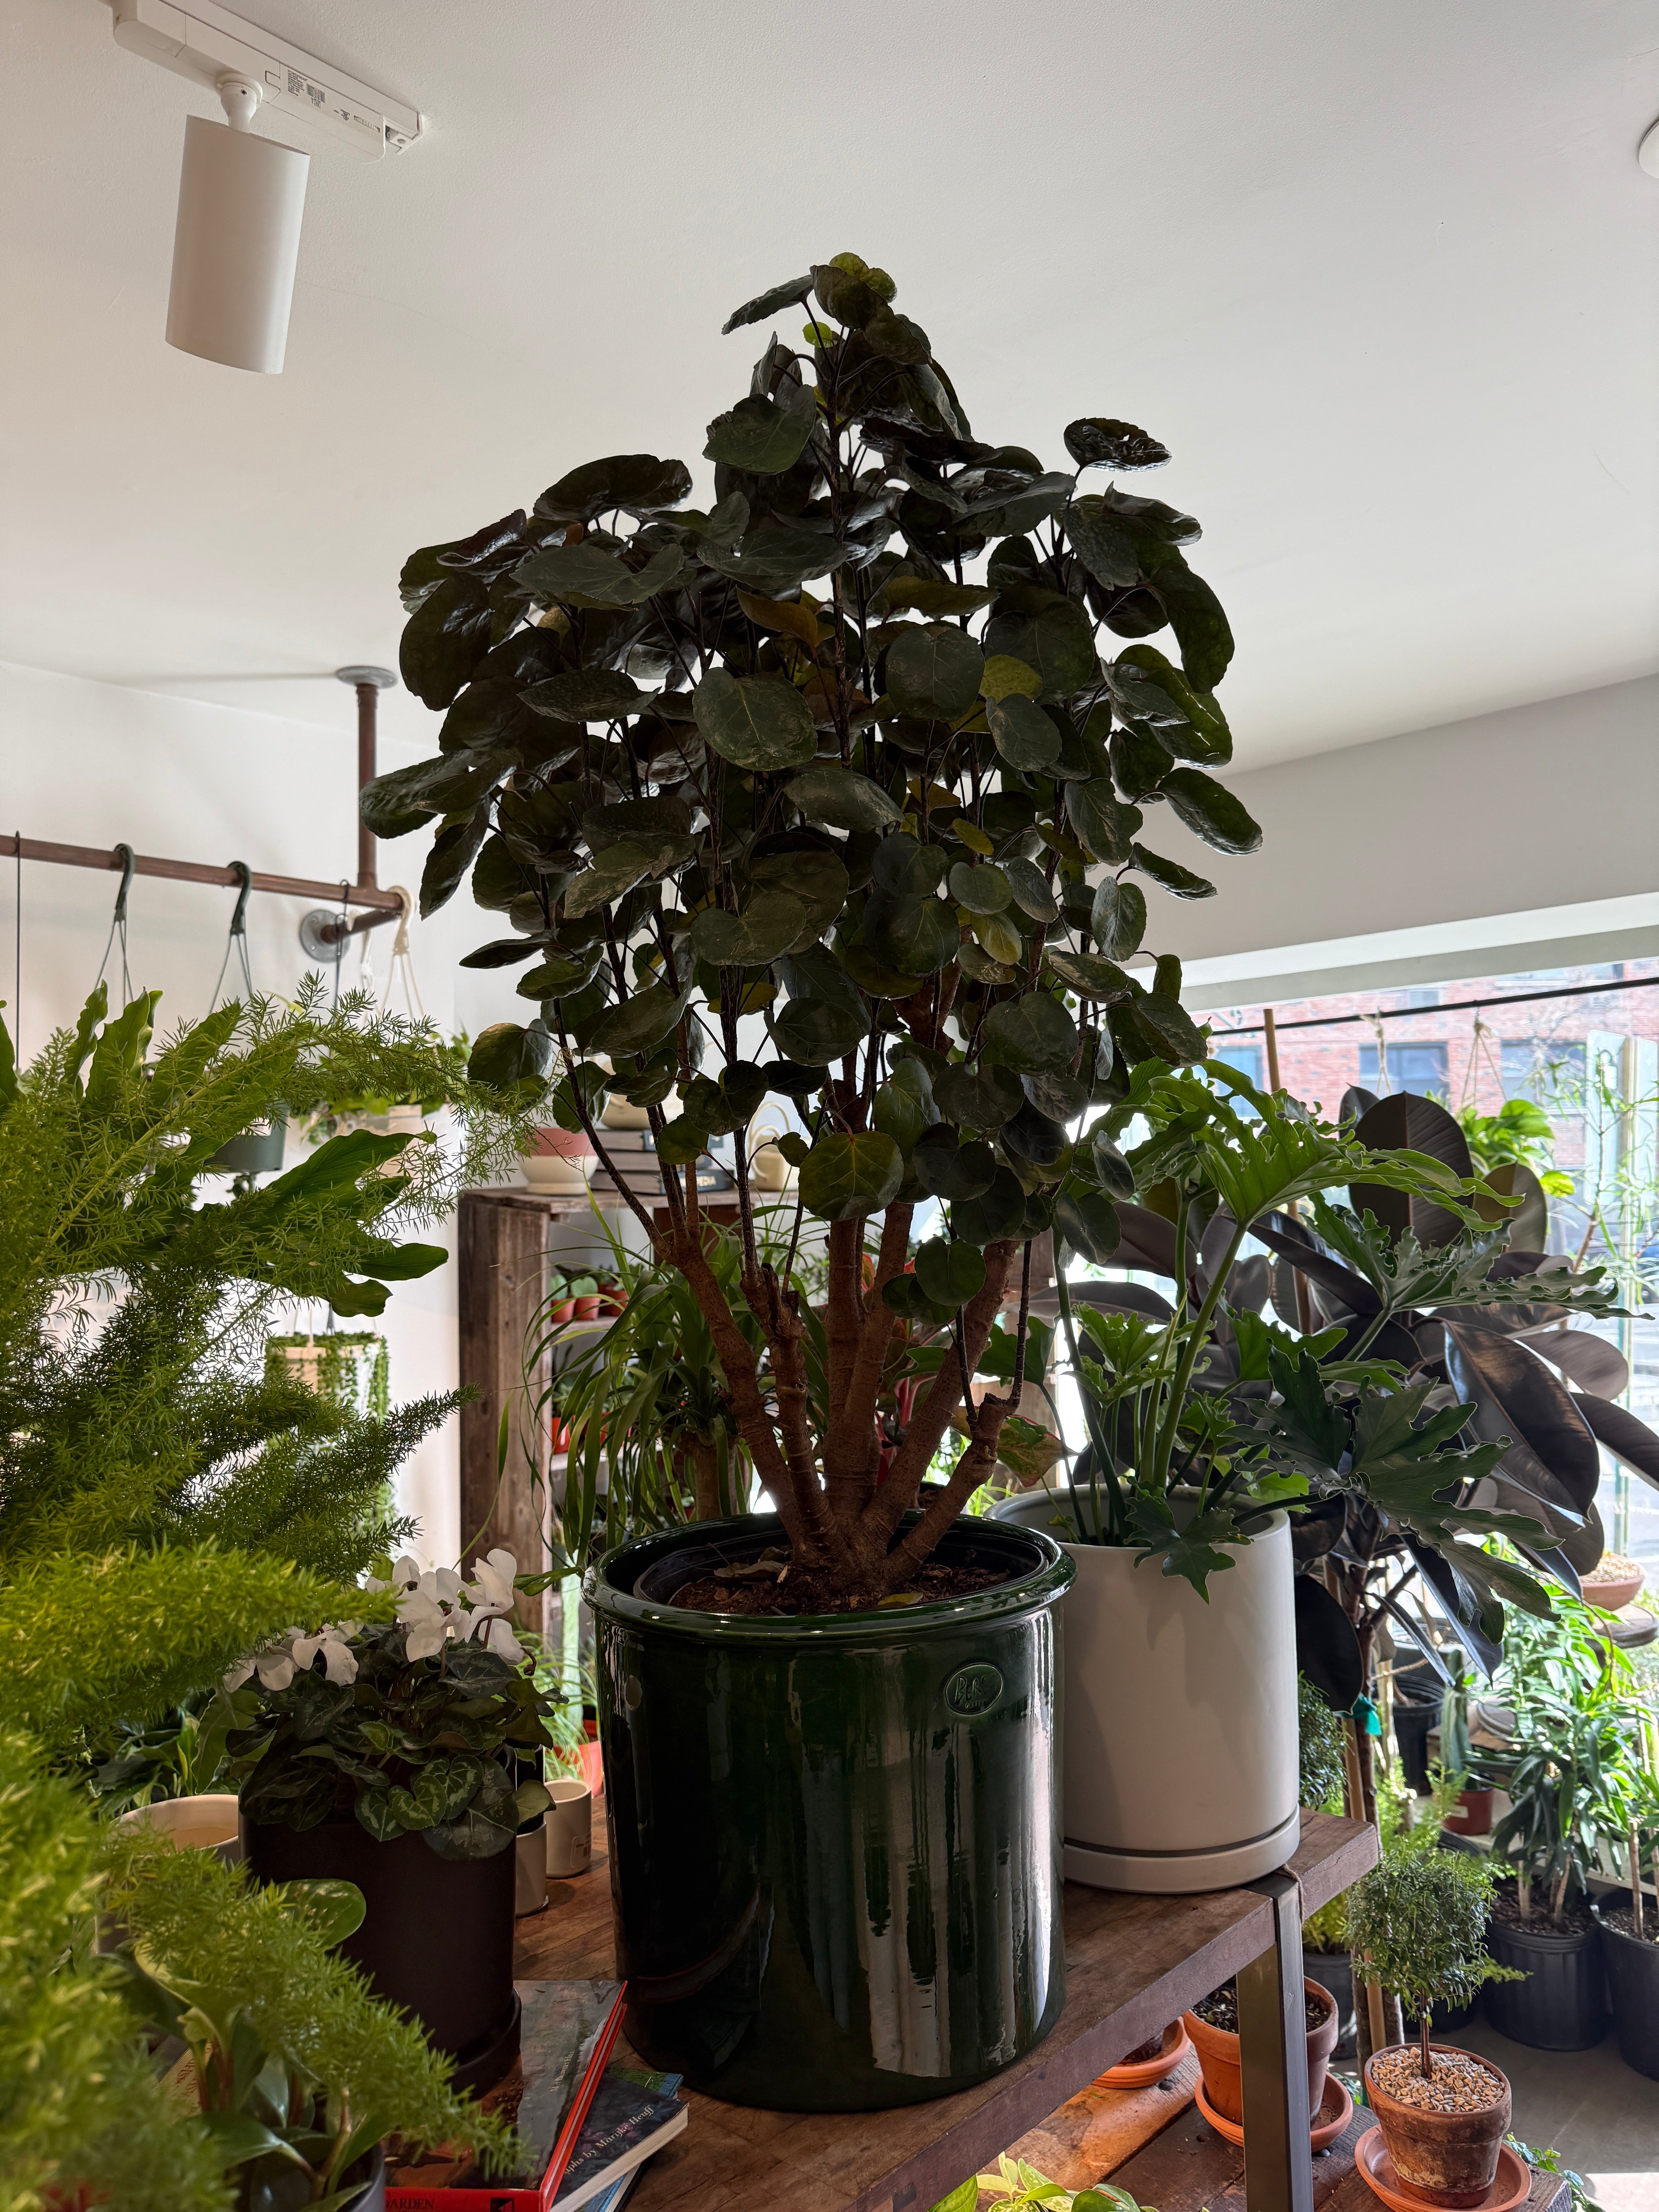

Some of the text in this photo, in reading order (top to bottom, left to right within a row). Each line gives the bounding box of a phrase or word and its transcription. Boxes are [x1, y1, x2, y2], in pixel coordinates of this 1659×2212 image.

[583, 2148, 597, 2158] by
[595, 2124, 629, 2148] Marijke
[629, 2105, 654, 2125] Heuff
